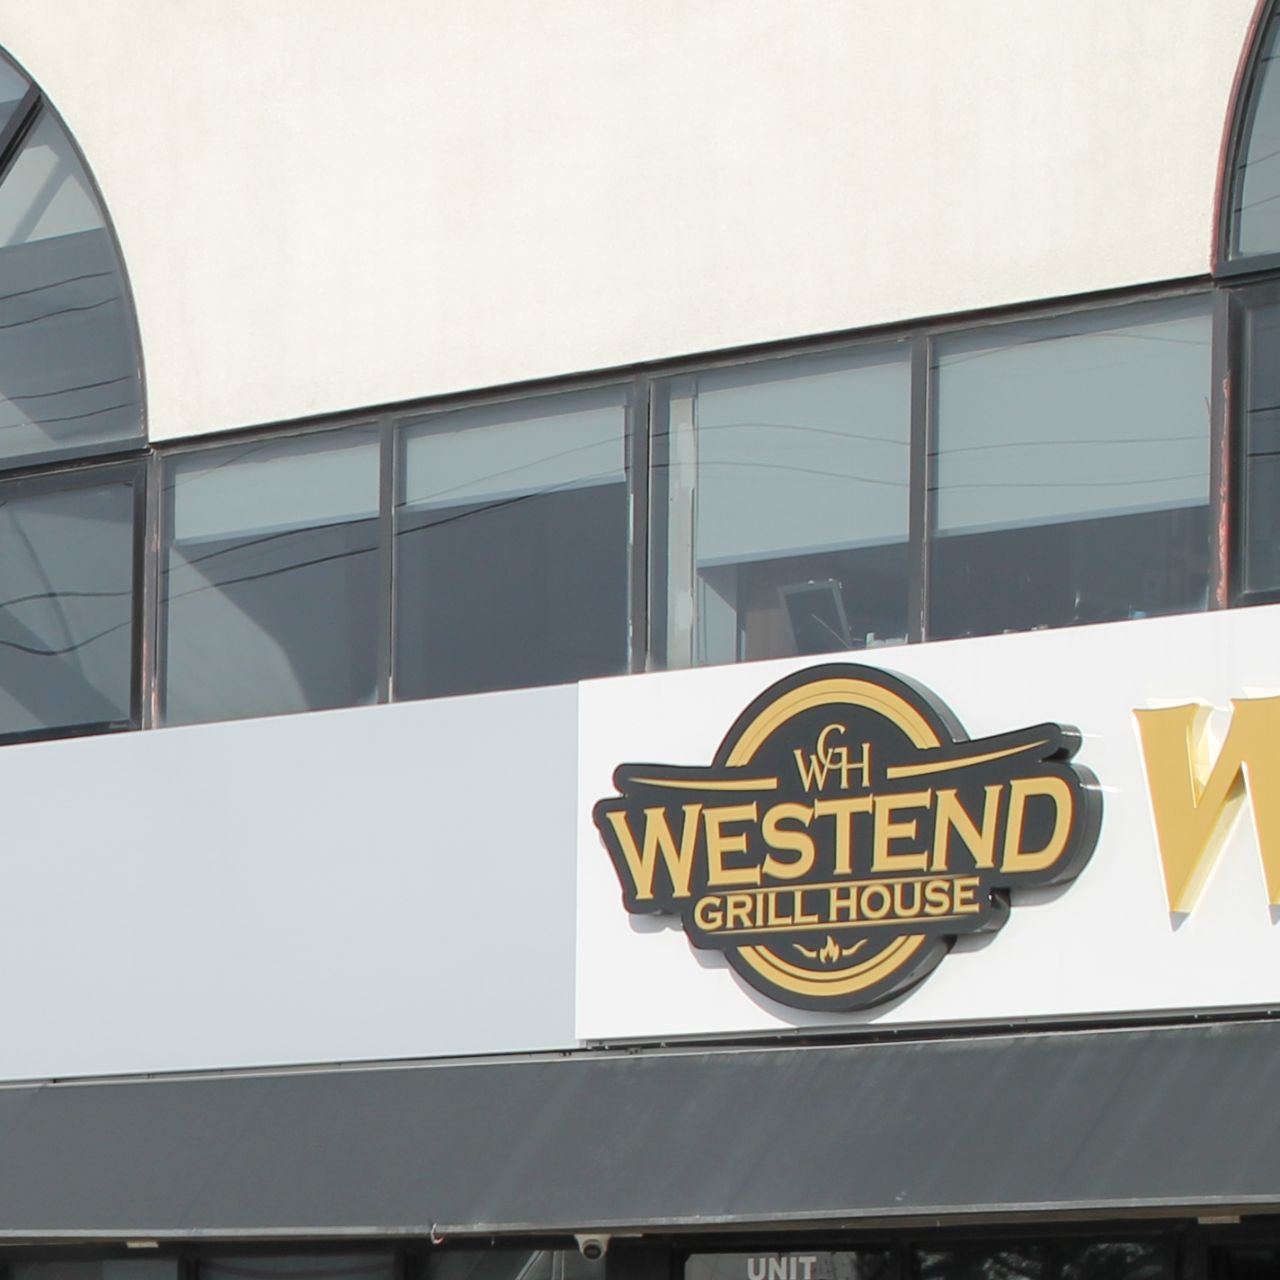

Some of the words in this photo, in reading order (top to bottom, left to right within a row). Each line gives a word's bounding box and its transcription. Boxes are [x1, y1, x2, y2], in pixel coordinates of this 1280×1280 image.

[606, 776, 1072, 900] WESTEND
[694, 889, 824, 931] GRILL
[829, 876, 981, 922] HOUSE
